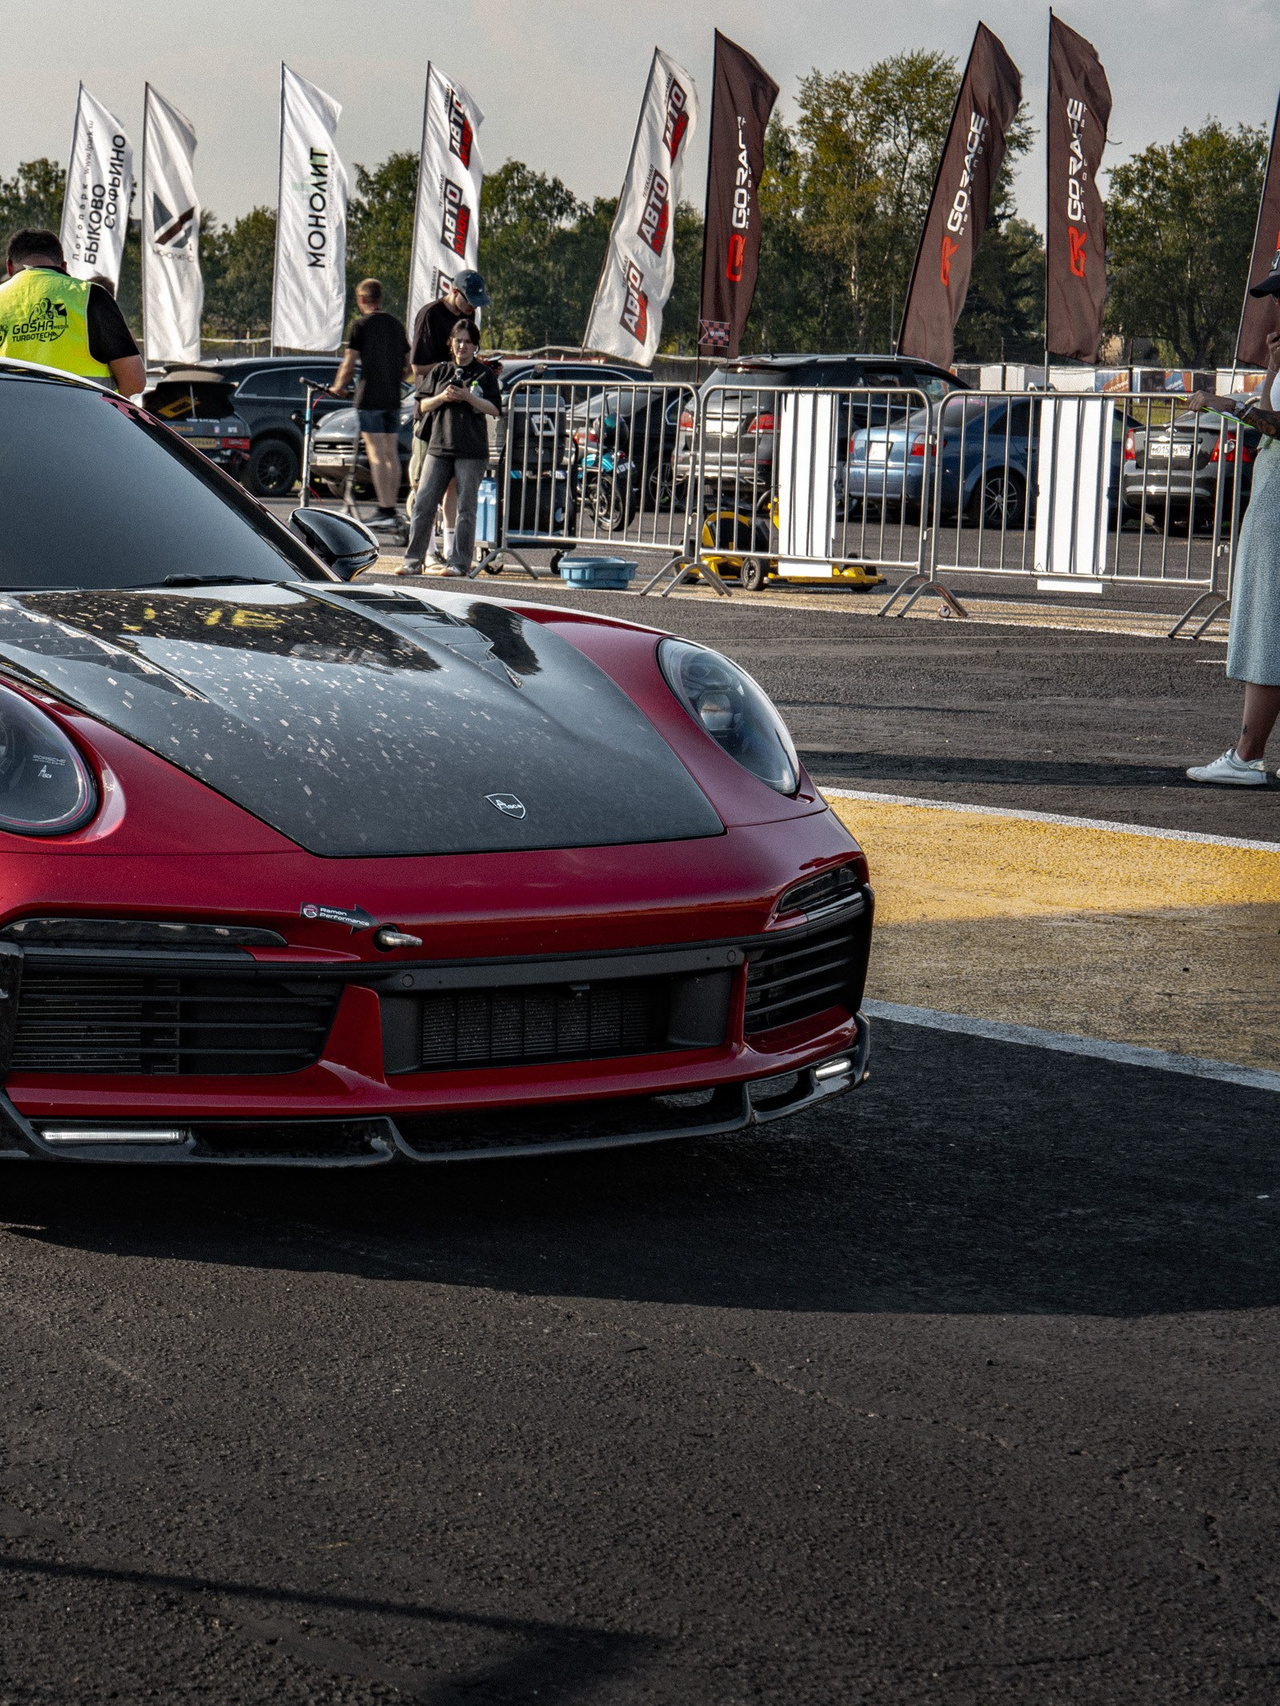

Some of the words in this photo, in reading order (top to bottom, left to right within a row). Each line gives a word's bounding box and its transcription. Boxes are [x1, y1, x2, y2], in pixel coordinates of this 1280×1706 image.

[104, 134, 126, 229] СОФЬИНО
[307, 147, 328, 268] МОНОЛИТ
[641, 176, 668, 245] АВТО
[732, 116, 748, 229] GORAC
[947, 112, 985, 232] GORACE
[72, 184, 88, 262] Логопарк
[84, 184, 106, 265] БЫКОВО
[444, 183, 460, 250] АВТО
[12, 320, 54, 335] GOSHA
[320, 907, 347, 916] Ramon
